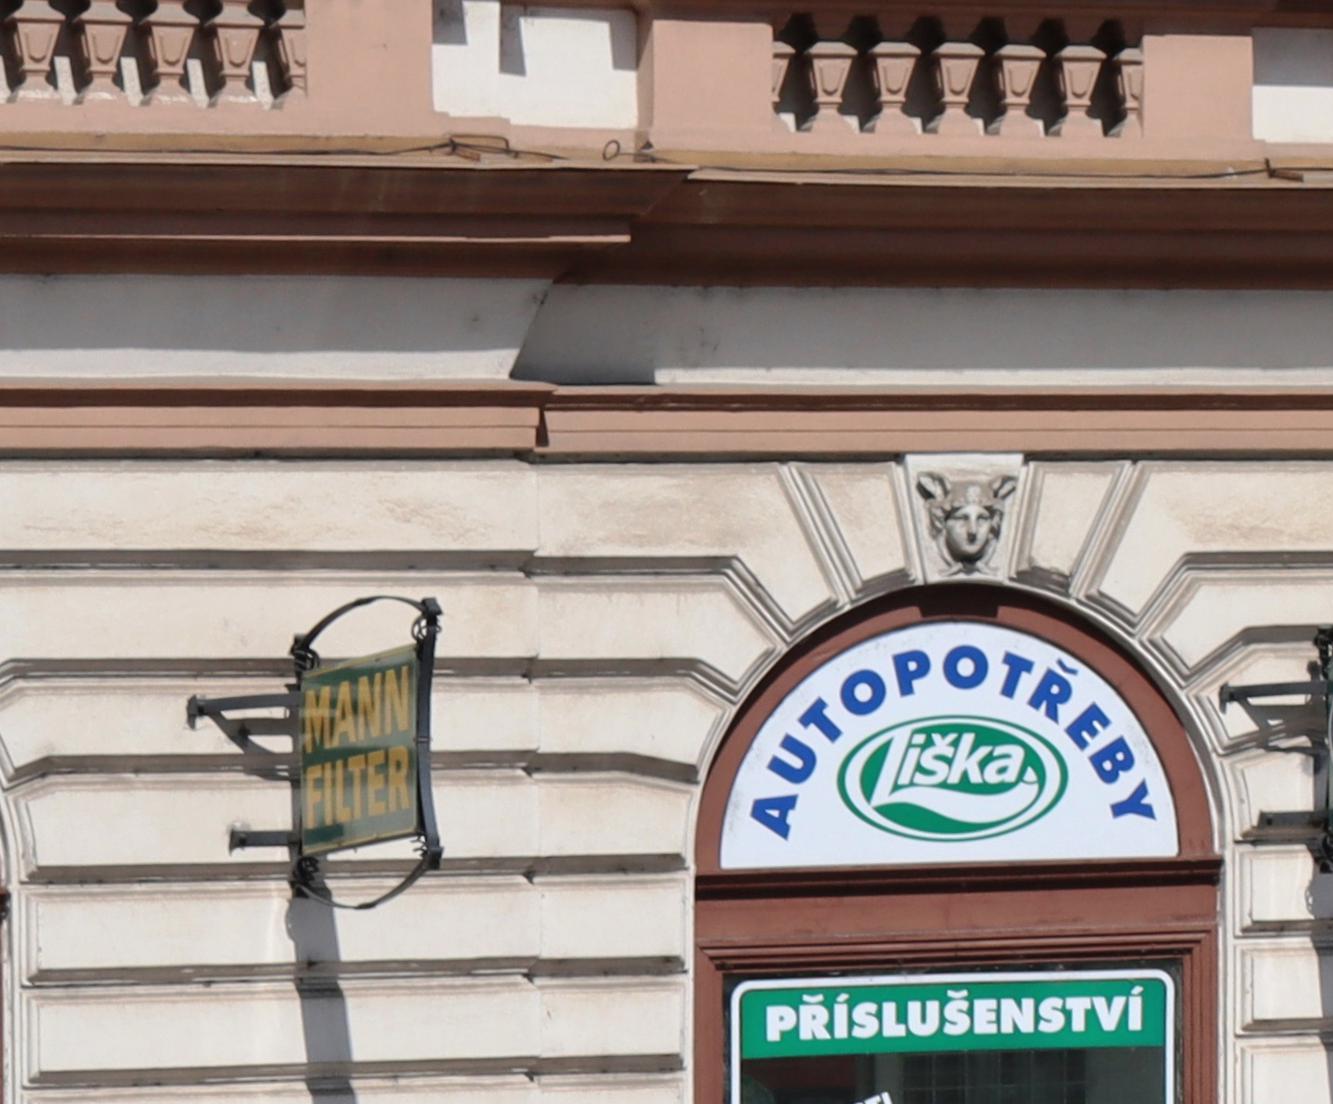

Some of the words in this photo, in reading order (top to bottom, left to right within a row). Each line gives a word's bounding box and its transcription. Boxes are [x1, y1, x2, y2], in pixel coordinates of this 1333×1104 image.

[304, 665, 411, 753] MANN
[749, 645, 1157, 840] AUTOPOTŘEBY
[305, 745, 411, 830] FILTER
[869, 725, 1040, 824] Liška
[765, 985, 1144, 1043] PŘÍSLUŠENSTVÍ
